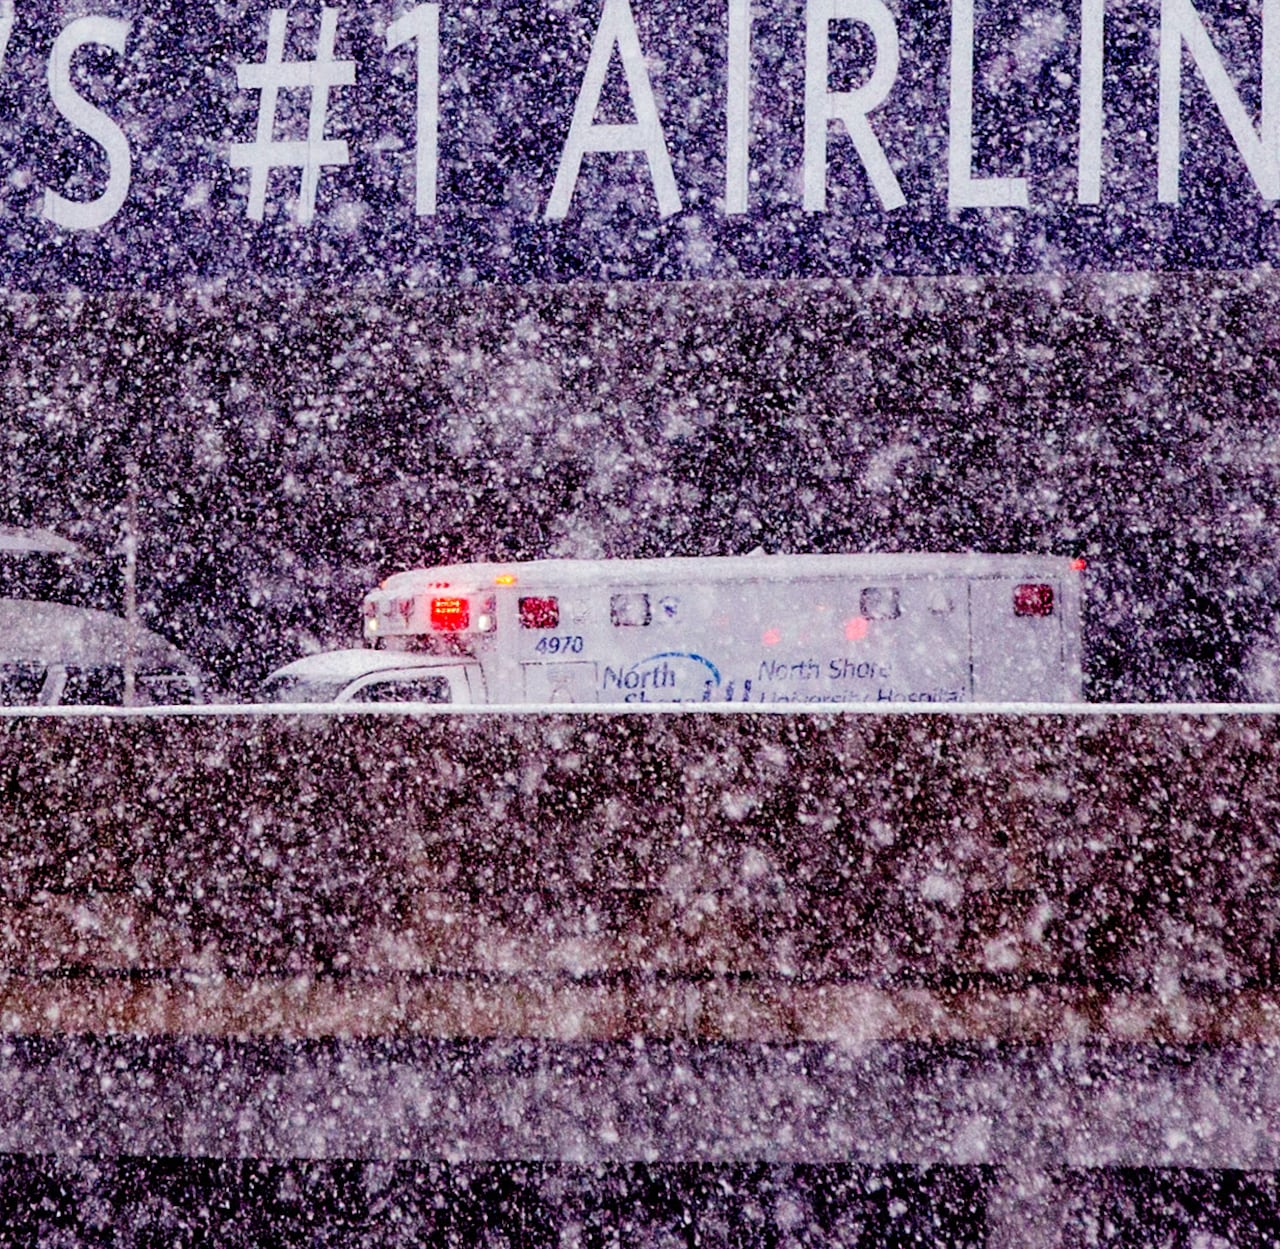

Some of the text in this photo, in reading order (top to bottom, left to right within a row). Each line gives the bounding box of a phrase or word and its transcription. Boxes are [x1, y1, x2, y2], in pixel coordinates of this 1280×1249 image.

[229, 1, 440, 223] #1
[534, 635, 585, 654] 4970
[602, 662, 677, 690] North
[758, 657, 893, 681] North Shore
